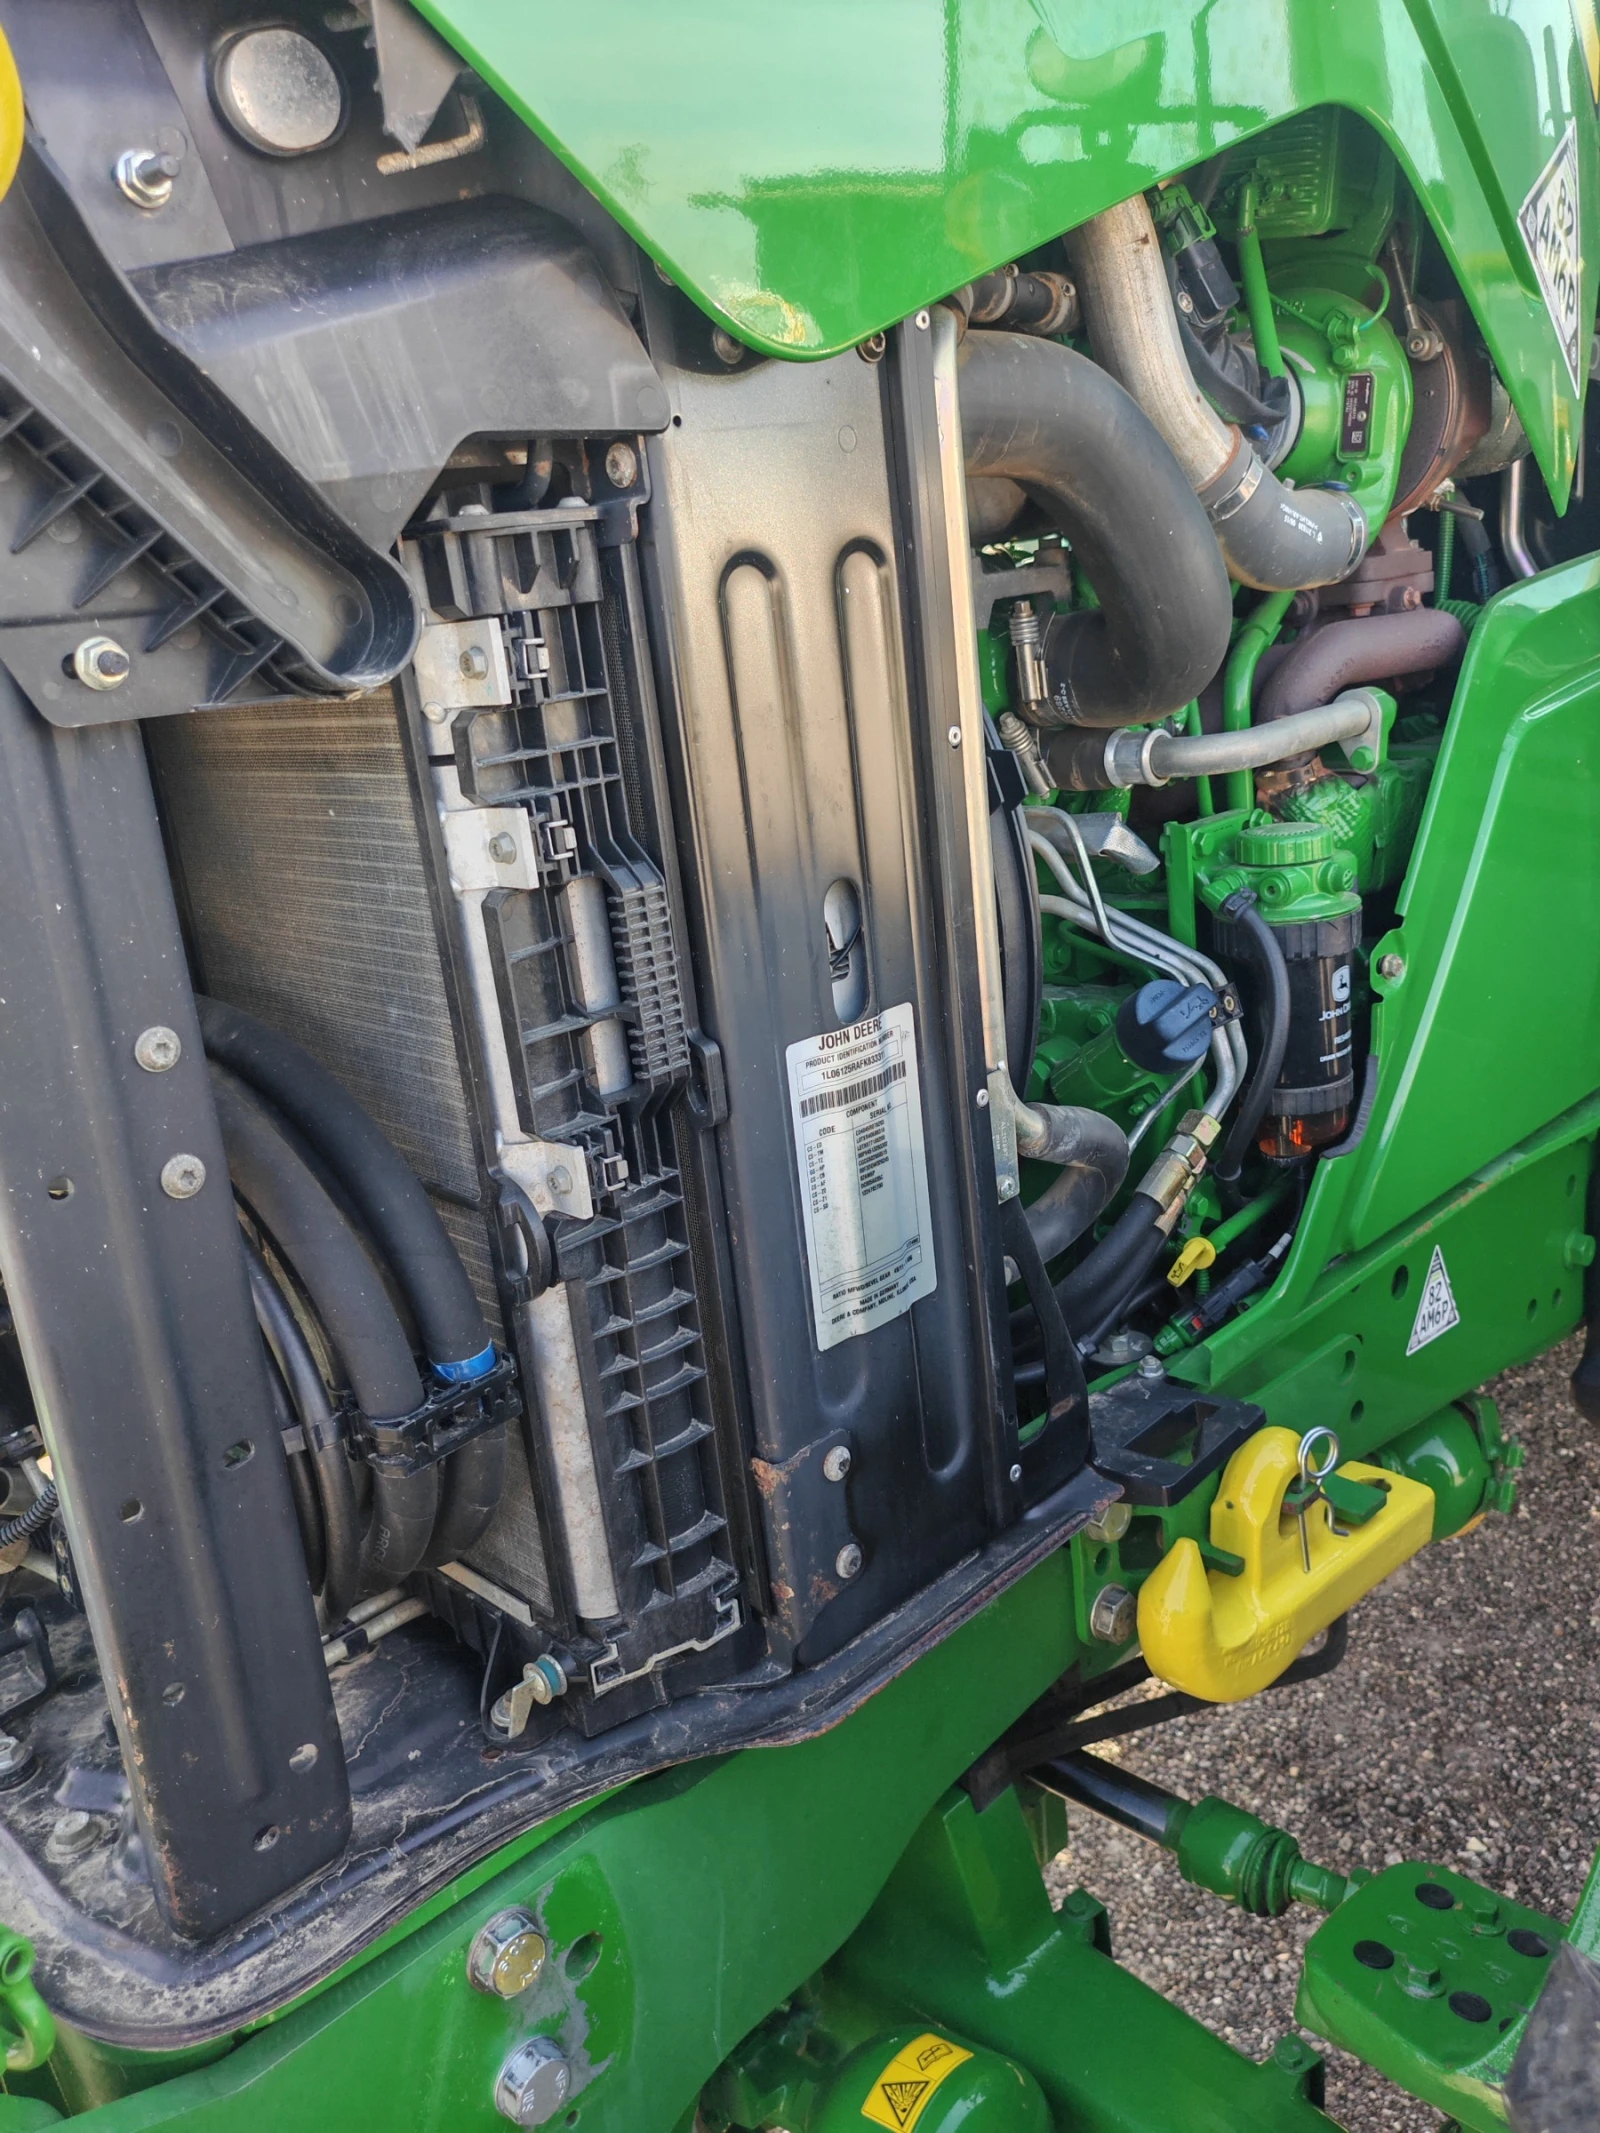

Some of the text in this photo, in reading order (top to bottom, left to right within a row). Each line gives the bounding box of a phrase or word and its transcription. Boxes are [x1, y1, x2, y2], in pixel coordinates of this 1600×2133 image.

[1319, 1006, 1343, 1021] JOHN
[818, 1015, 884, 1051] JOHN DEERE
[805, 1054, 836, 1070] PRODUCT
[836, 1040, 878, 1061] IDENTIFICATION
[845, 1099, 878, 1118] COMPONENT
[818, 1125, 836, 1137] CODE
[869, 1106, 887, 1119] SERIAL
[832, 1289, 847, 1300] RATIO
[859, 1296, 873, 1306] MADE
[879, 1281, 900, 1297] GERMANY
[1428, 1281, 1442, 1307] 82
[831, 1313, 846, 1325] DEERE
[1420, 1300, 1449, 1333] AM6P
